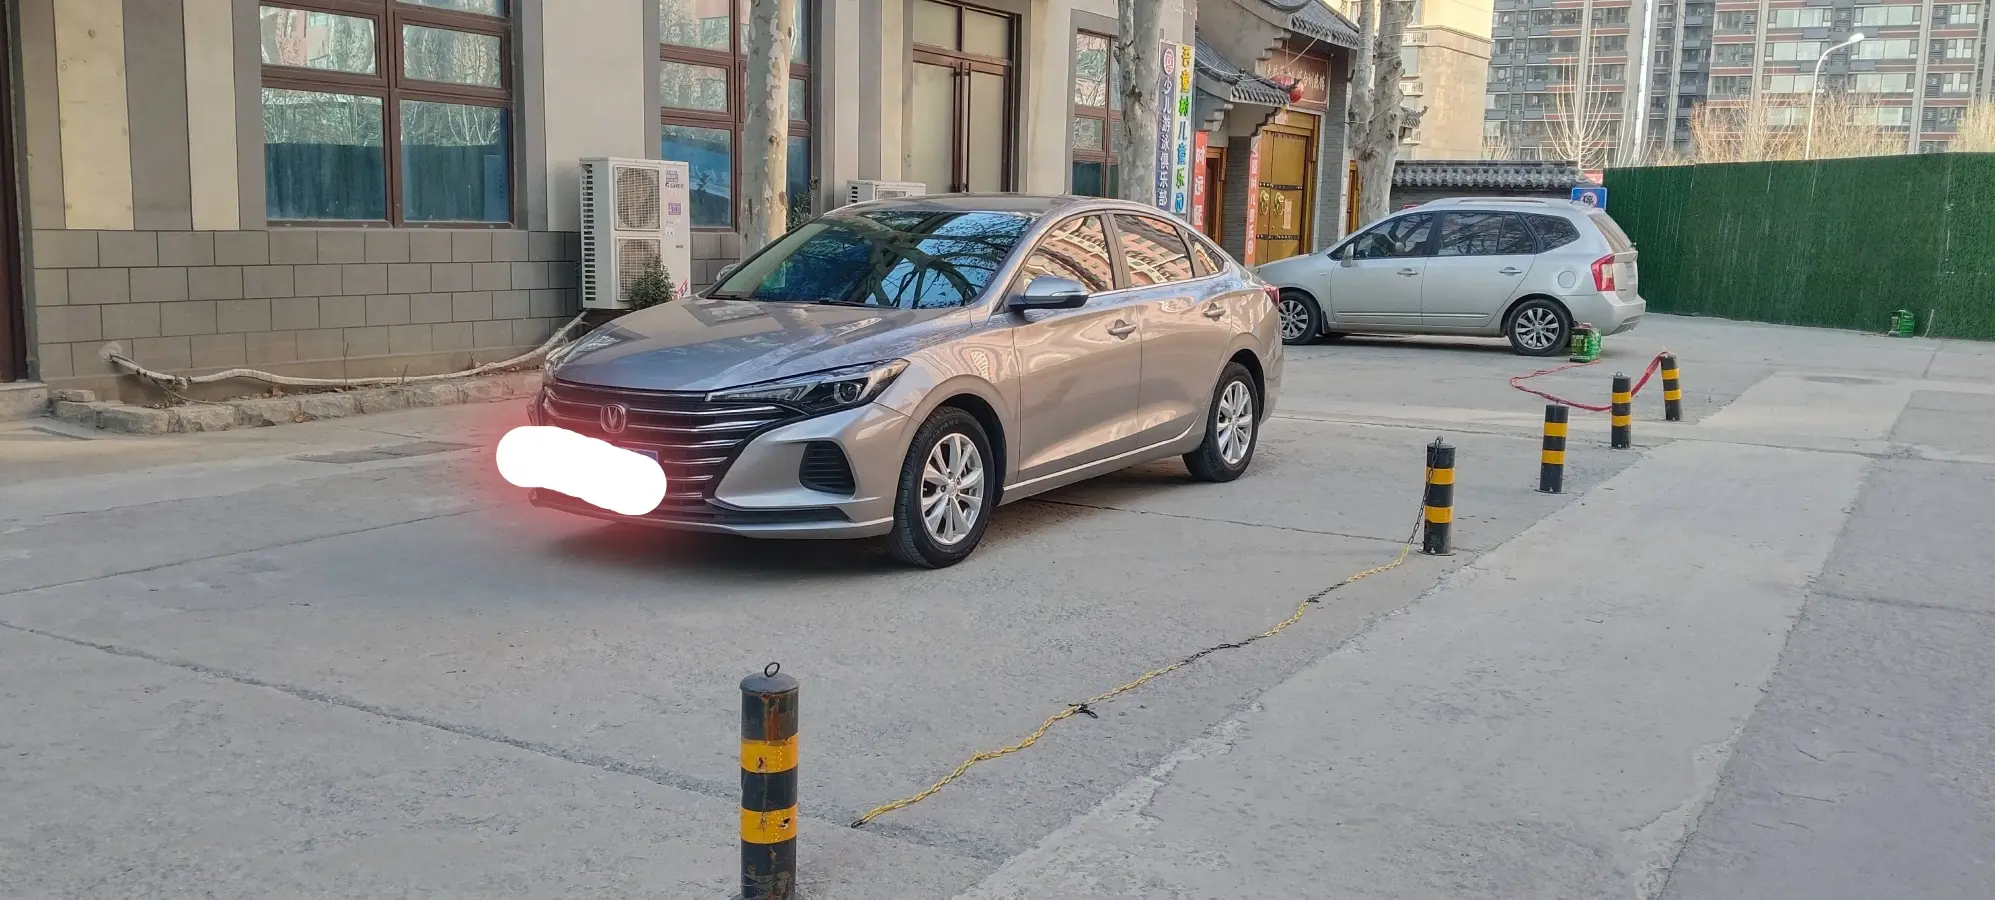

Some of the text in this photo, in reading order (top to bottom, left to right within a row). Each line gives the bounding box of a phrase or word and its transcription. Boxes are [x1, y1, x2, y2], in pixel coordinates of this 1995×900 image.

[1158, 77, 1173, 206] 少儿游泳俱乐部
